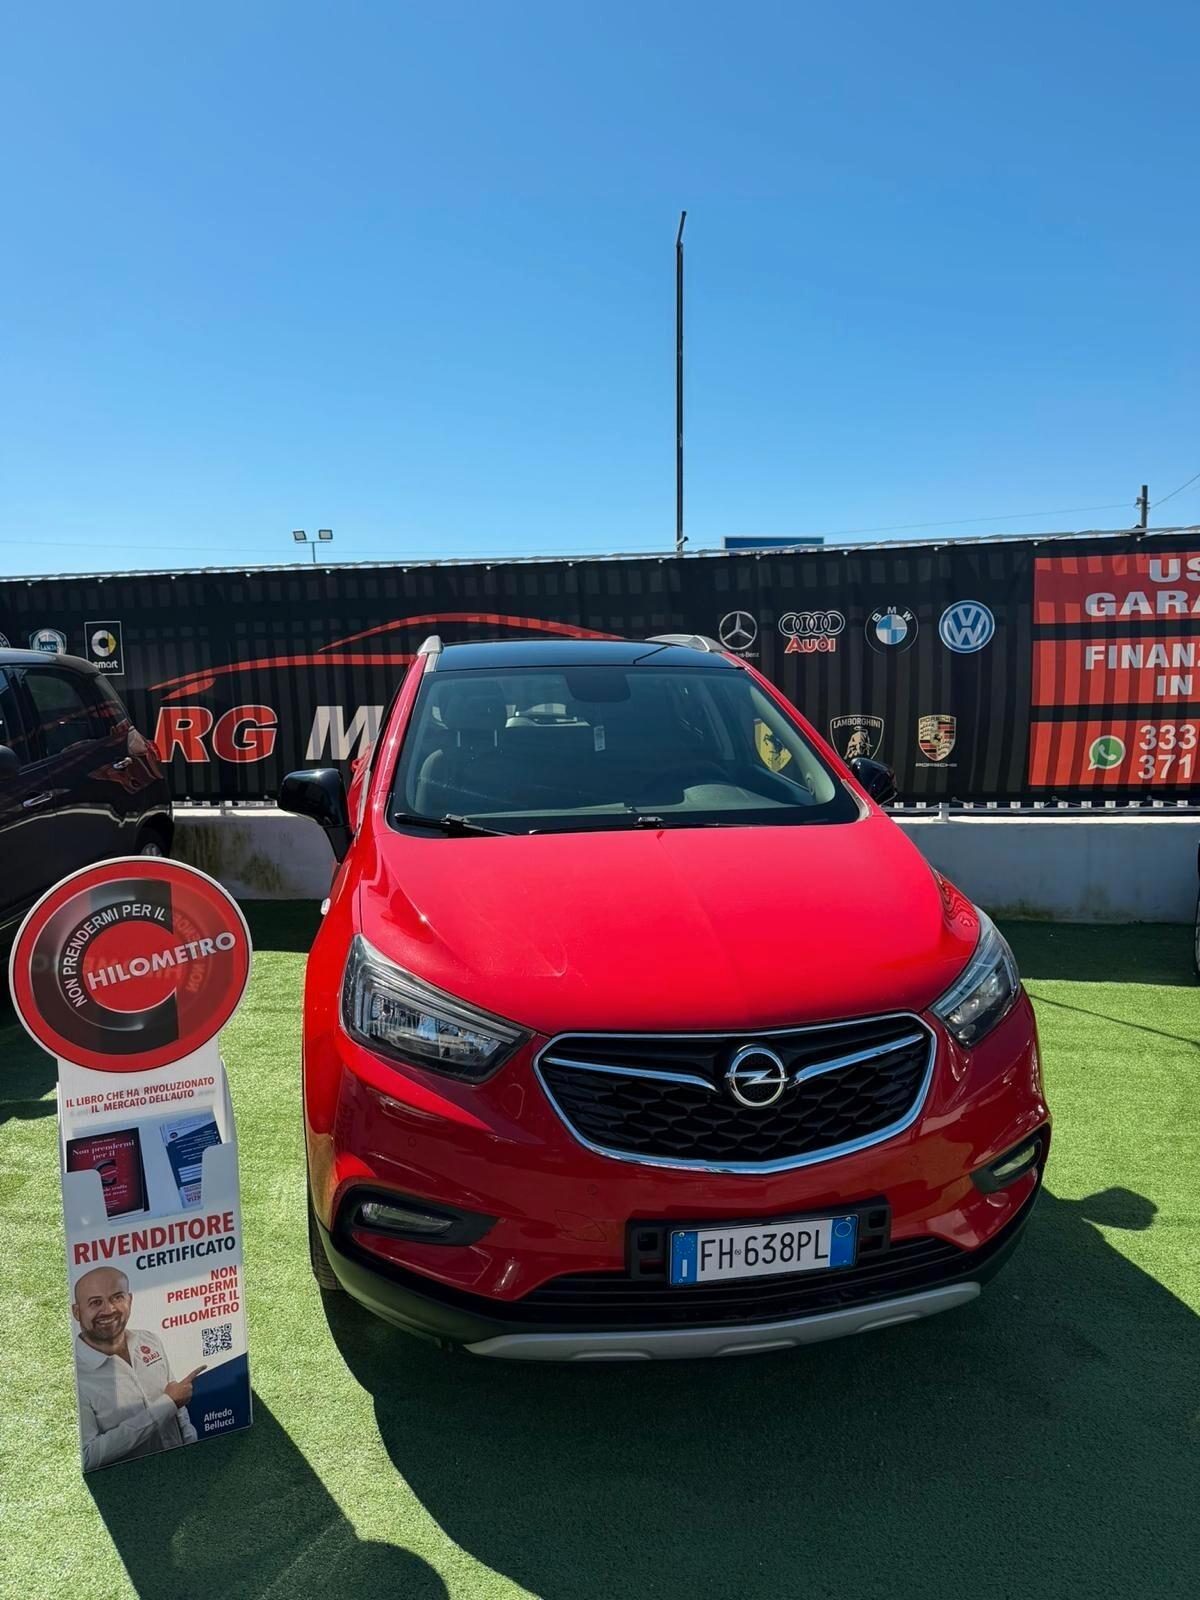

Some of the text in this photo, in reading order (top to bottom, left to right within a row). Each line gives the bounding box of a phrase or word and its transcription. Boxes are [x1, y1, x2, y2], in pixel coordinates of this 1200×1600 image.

[872, 606, 914, 622] BMW
[1085, 590, 1200, 616] GAR
[784, 635, 836, 654] Audi
[1085, 643, 1200, 670] FINAN
[93, 660, 119, 669] smart
[1157, 675, 1193, 696] IN
[153, 705, 278, 763] RG
[833, 717, 881, 729] LAMBORGHINI
[1139, 724, 1197, 750] 333
[1138, 753, 1194, 780] 371
[63, 903, 166, 1008] NON PRENDERMI PER IL
[86, 931, 237, 991] HILOMETRO
[66, 1076, 215, 1109] IL LIBRO CHE HA RIVOLUZIONATO
[91, 1089, 195, 1114] IL MERCATO DELL'AUTO
[72, 1148, 90, 1156] Non
[91, 1139, 135, 1154] prendermi
[73, 1211, 235, 1266] RIVENDITORE
[700, 1237, 734, 1272] FH
[744, 1230, 828, 1267] 638PL
[136, 1236, 236, 1271] CERTIFICATO
[210, 1264, 238, 1281] NON
[167, 1277, 238, 1304] PRENDERMI
[203, 1291, 240, 1308] PER IL
[161, 1301, 240, 1330] CHILOMETRO
[203, 1407, 233, 1423] Alfredo
[204, 1416, 235, 1432] Bellucci
